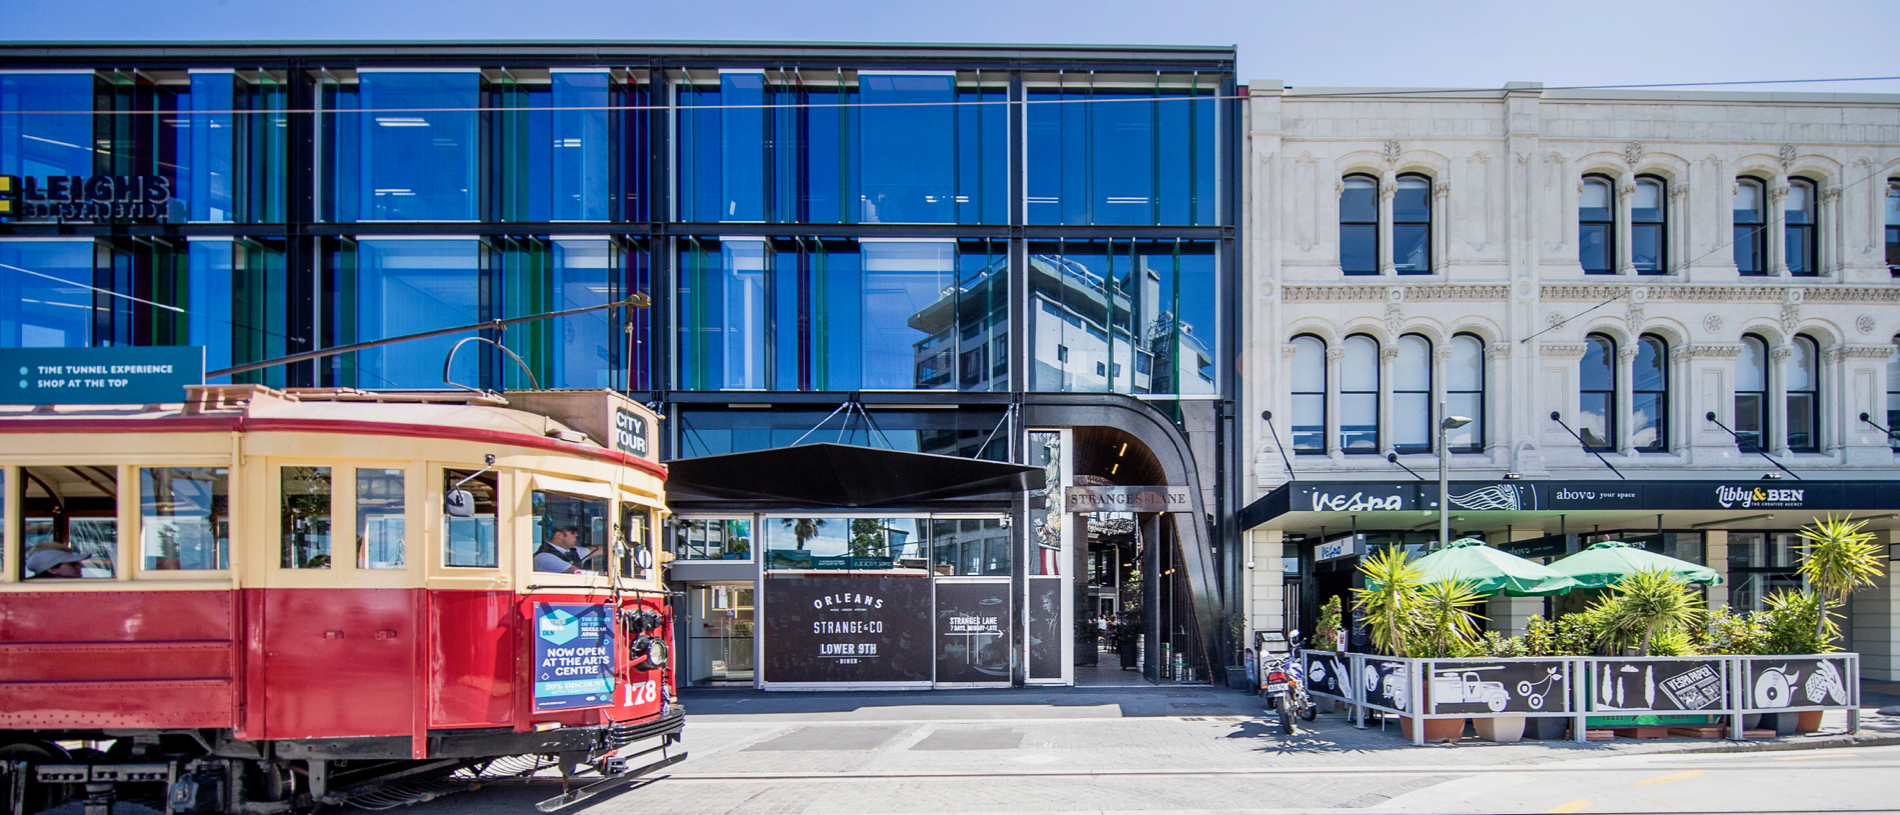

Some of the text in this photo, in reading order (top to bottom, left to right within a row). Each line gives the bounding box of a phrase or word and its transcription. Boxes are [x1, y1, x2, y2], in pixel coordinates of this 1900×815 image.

[24, 175, 171, 204] LEIGHS
[24, 203, 170, 219] CONSTRUCTION
[38, 364, 173, 375] TIME TUNNEL EXPERIENCE
[37, 379, 129, 388] SHOP AT THE TOP
[616, 411, 642, 434] CITY
[616, 428, 646, 453] TOUR
[1071, 493, 1186, 505] STRANGES LANE
[1556, 487, 1636, 500] above your space
[813, 592, 883, 609] ORLEANS
[950, 616, 998, 625] STRANGES LANE
[547, 647, 606, 658] NOW OPEN
[820, 643, 877, 655] LOWER 9TH
[542, 656, 610, 668] AT THE ARTS
[555, 666, 599, 677] CENTRE
[1666, 666, 1713, 691] VESPA PAPER
[545, 680, 605, 691] 20% DISCOUNT
[624, 680, 657, 707] 178
